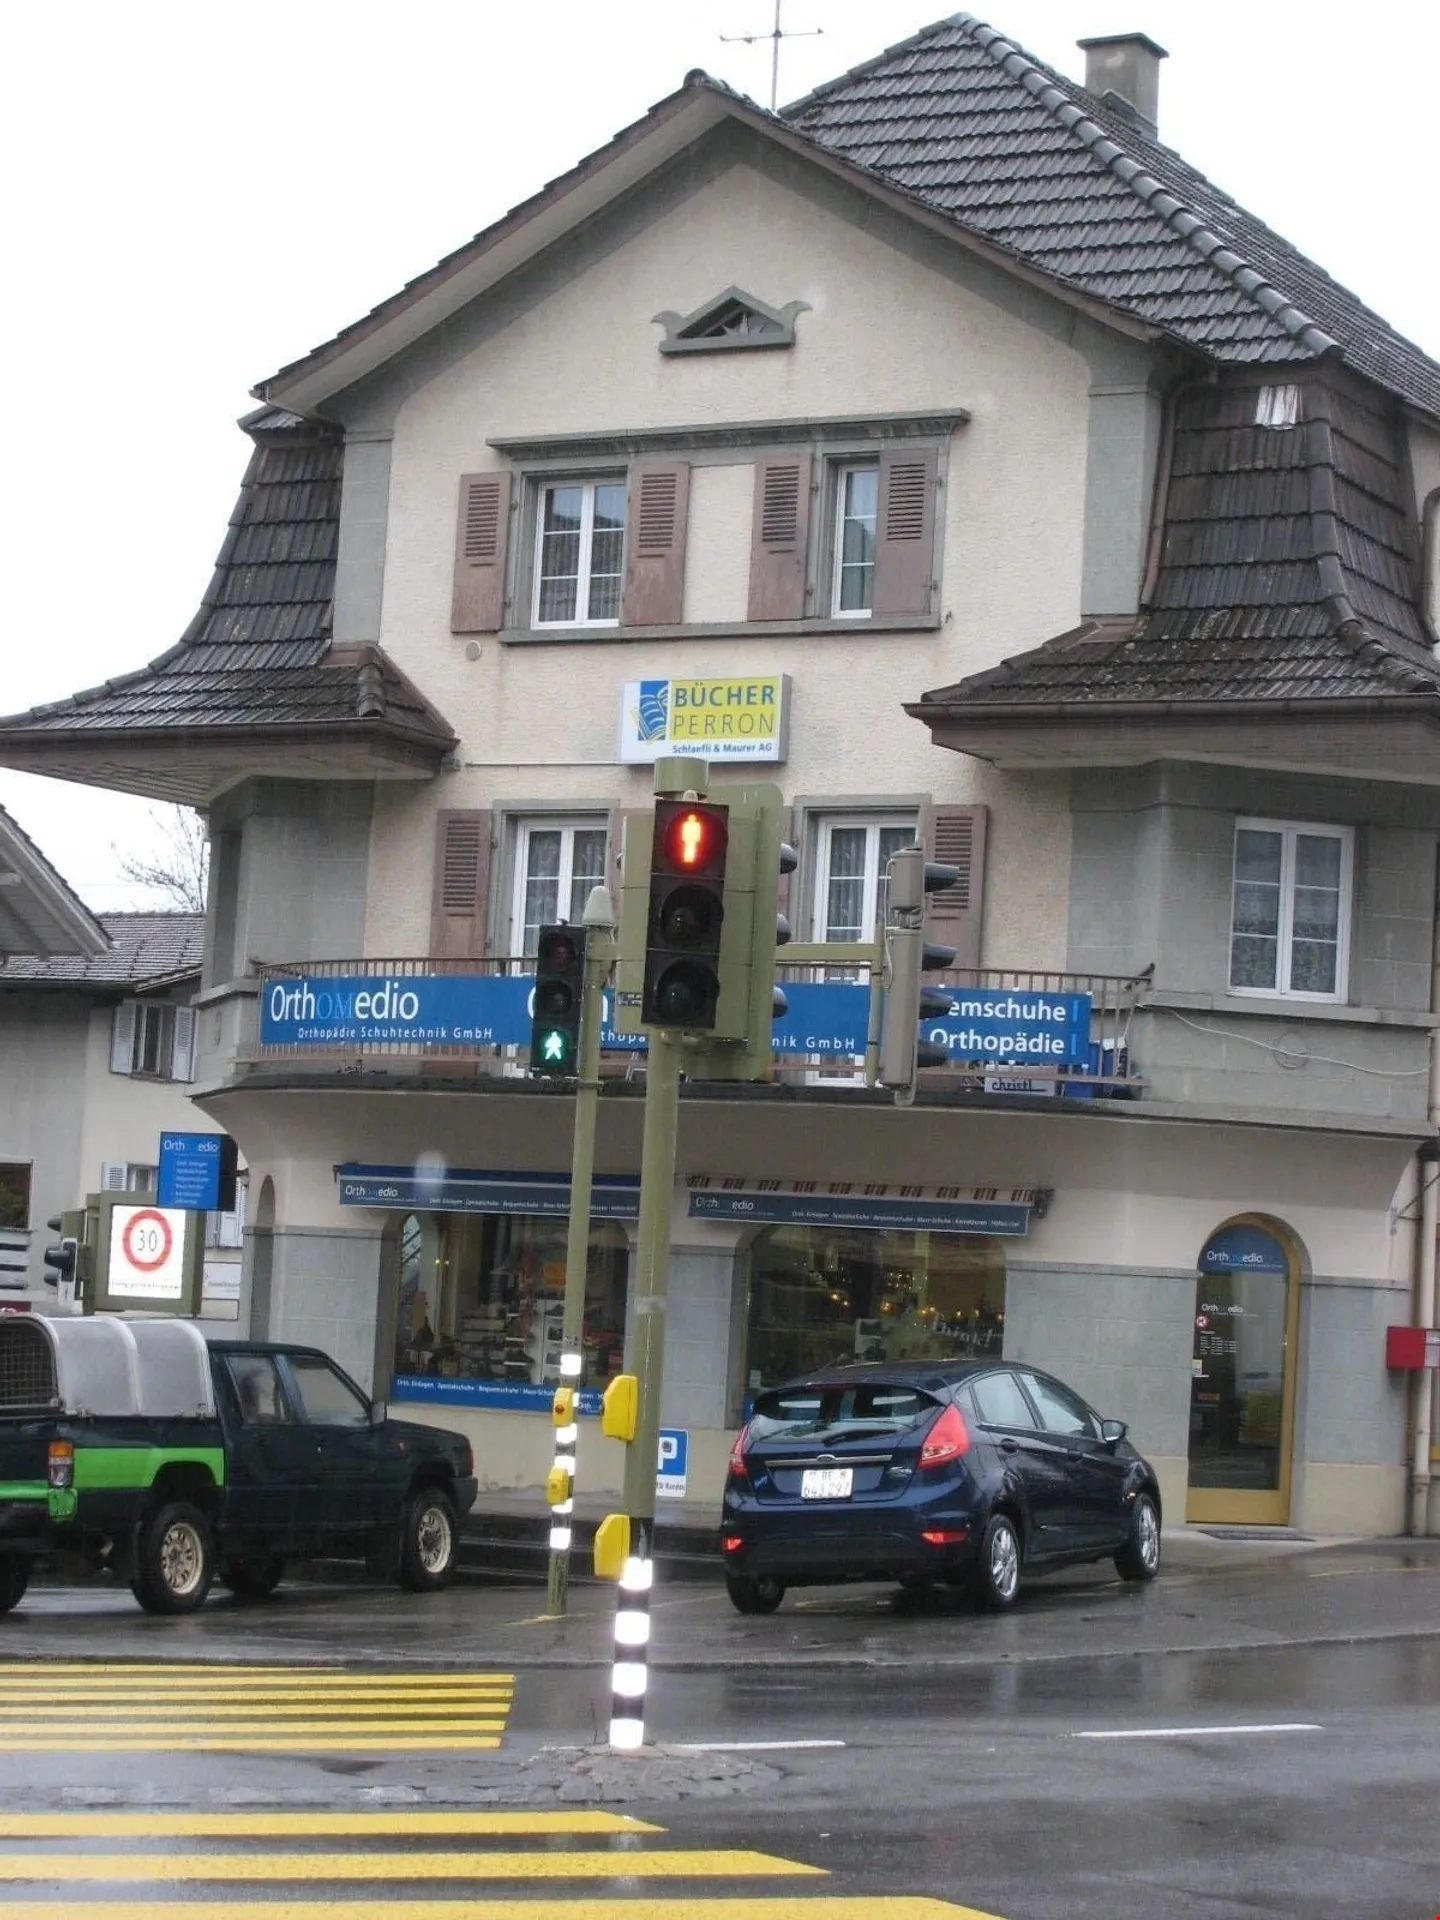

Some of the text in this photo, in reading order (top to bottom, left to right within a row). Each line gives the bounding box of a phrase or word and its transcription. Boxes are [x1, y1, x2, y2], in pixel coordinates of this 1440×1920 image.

[674, 682, 776, 708] BÜCHER
[673, 712, 774, 735] PERRON
[713, 745, 721, 753] &
[723, 743, 756, 753] Maurer
[758, 742, 773, 752] AG
[948, 998, 1067, 1022] emschuhe
[298, 1026, 493, 1040] Orthopädie Schuhtechnik GmbH
[805, 1036, 855, 1049] GmbH
[929, 1028, 1065, 1056] Orthopädie
[137, 1229, 158, 1252] 30
[658, 1436, 679, 1471] P
